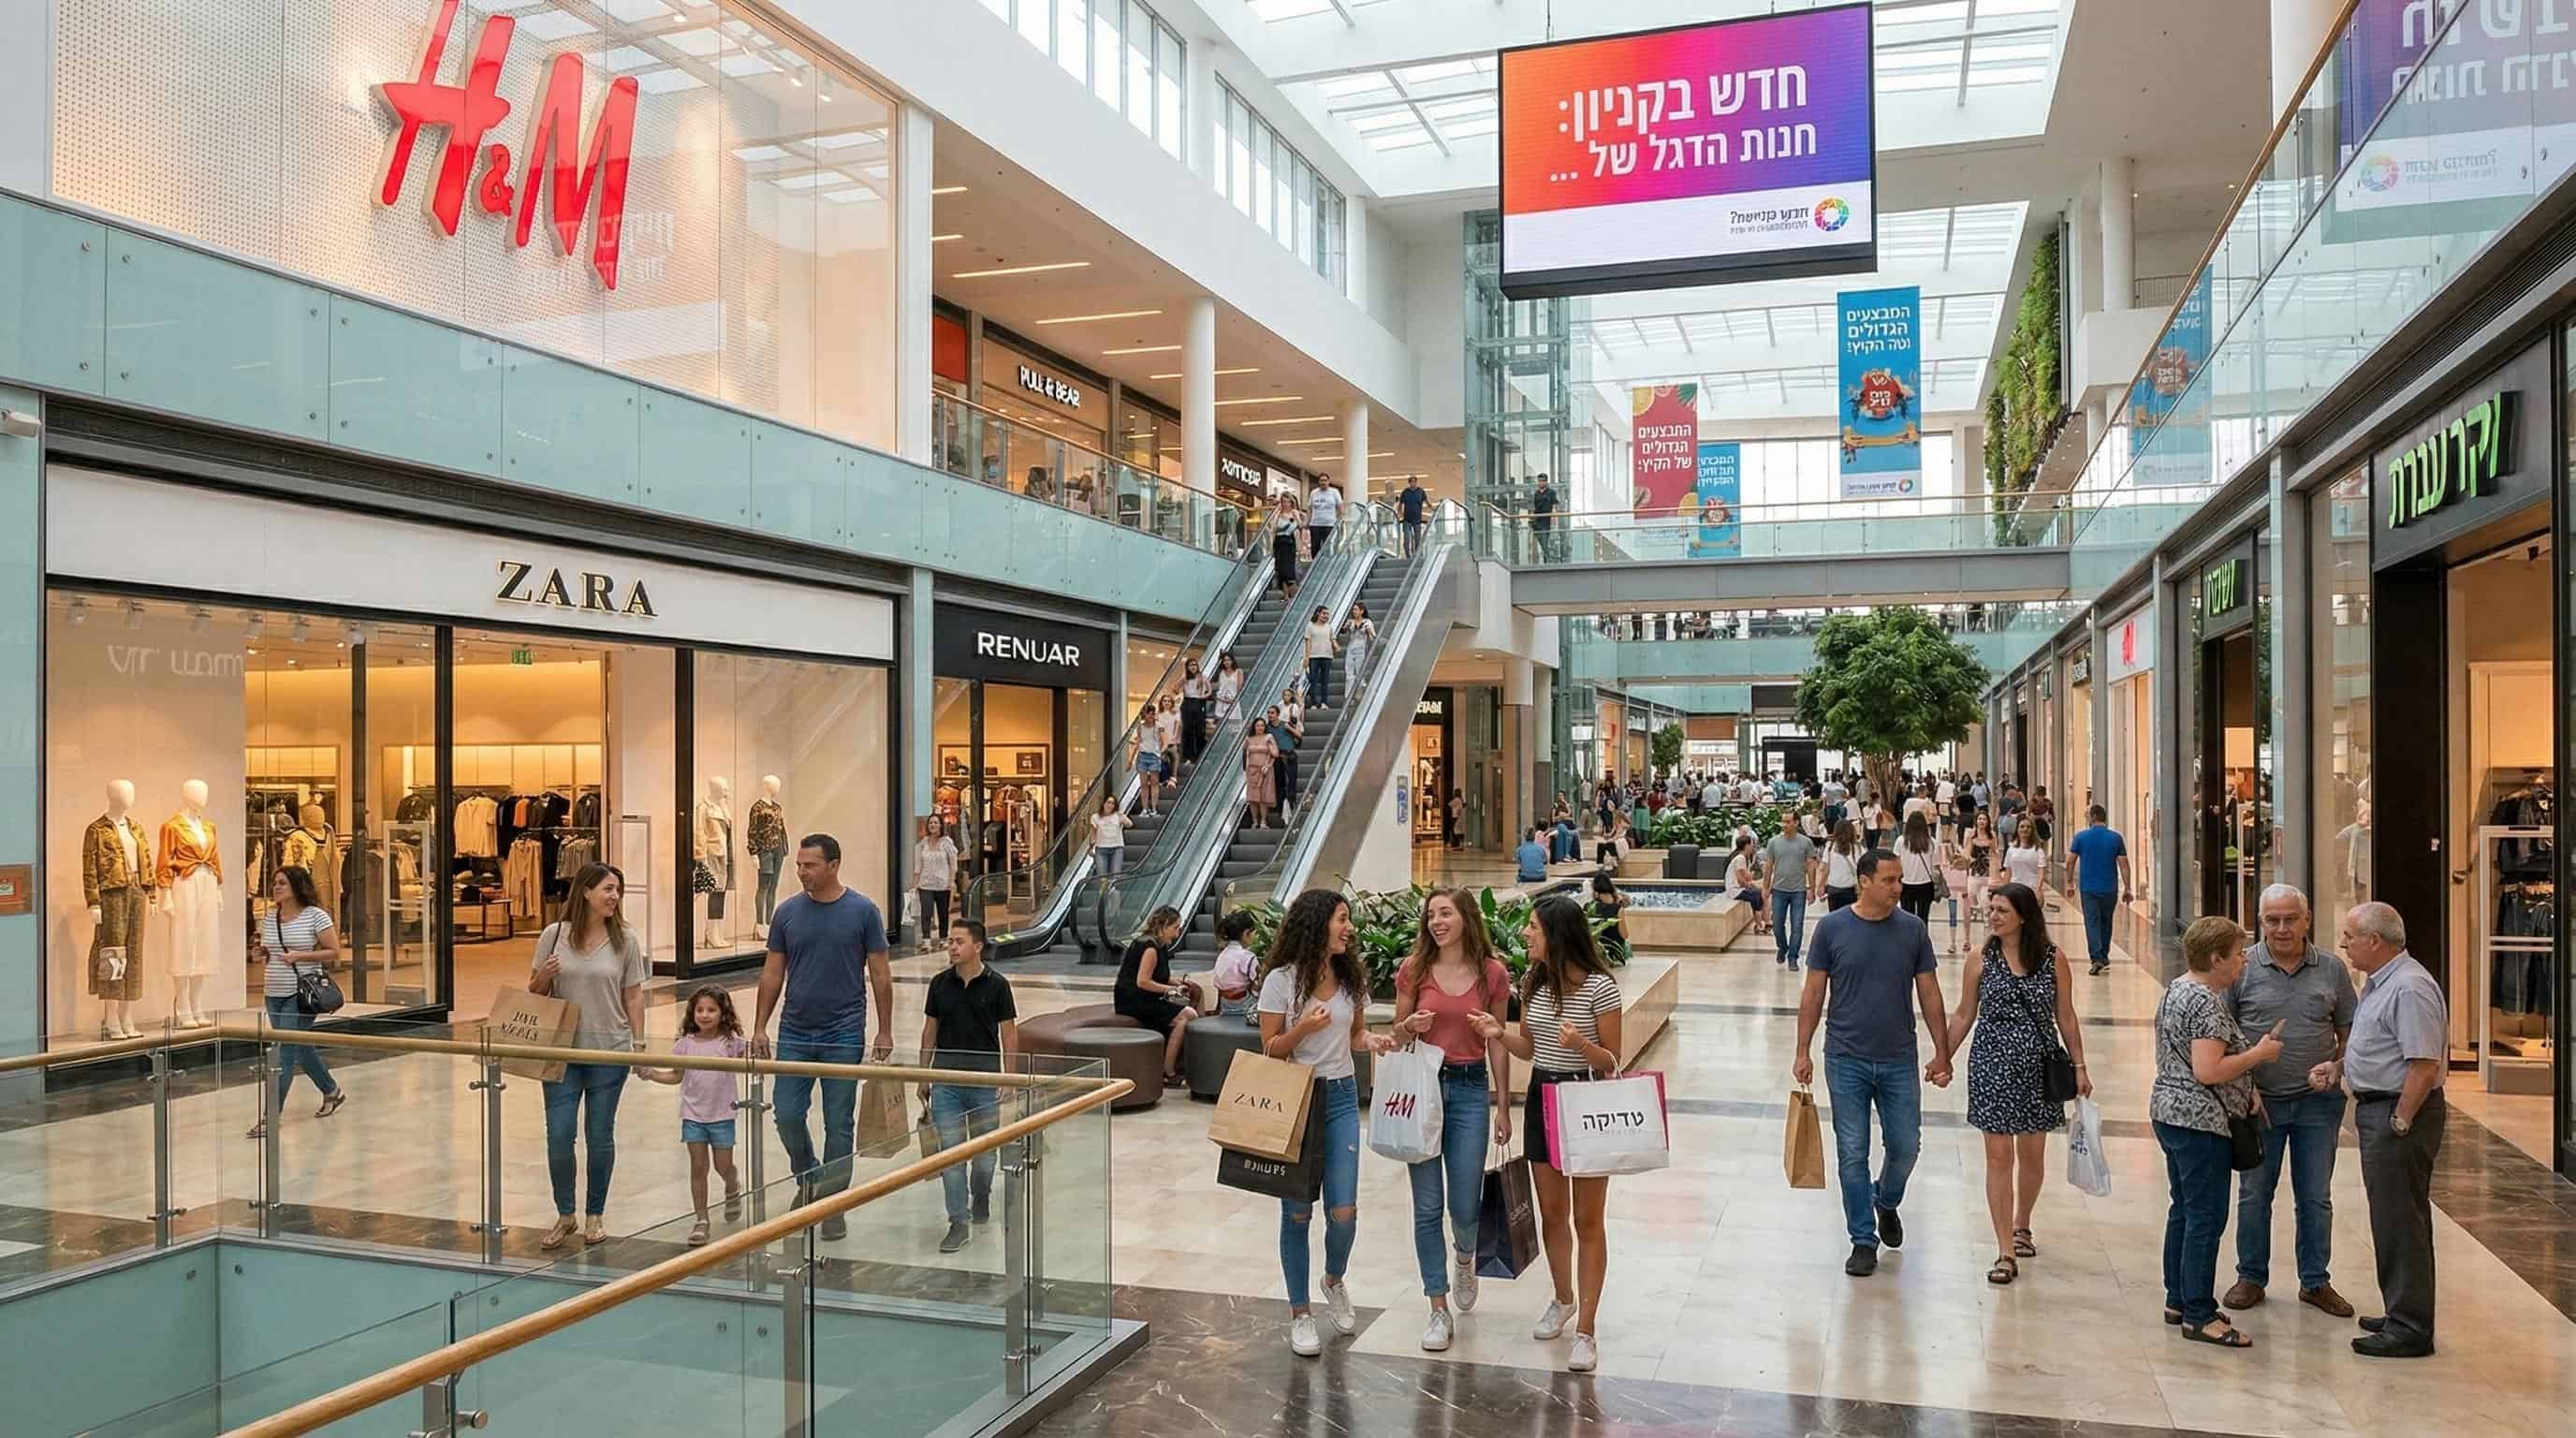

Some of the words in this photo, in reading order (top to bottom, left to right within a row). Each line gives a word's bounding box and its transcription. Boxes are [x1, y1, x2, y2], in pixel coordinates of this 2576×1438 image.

[1708, 65, 1807, 116] חדש
[1558, 79, 1695, 142] בקניון:
[372, 0, 638, 289] H&M
[1588, 139, 1637, 178] של
[1649, 132, 1728, 171] הדגל
[1739, 123, 1817, 162] חנות
[1846, 306, 1910, 322] המבצעים
[1848, 322, 1909, 338] הגדולים
[1674, 454, 1692, 469] של
[496, 561, 659, 617] ZARA
[977, 631, 1079, 667] RENUAR
[1234, 1093, 1282, 1113] ZARA
